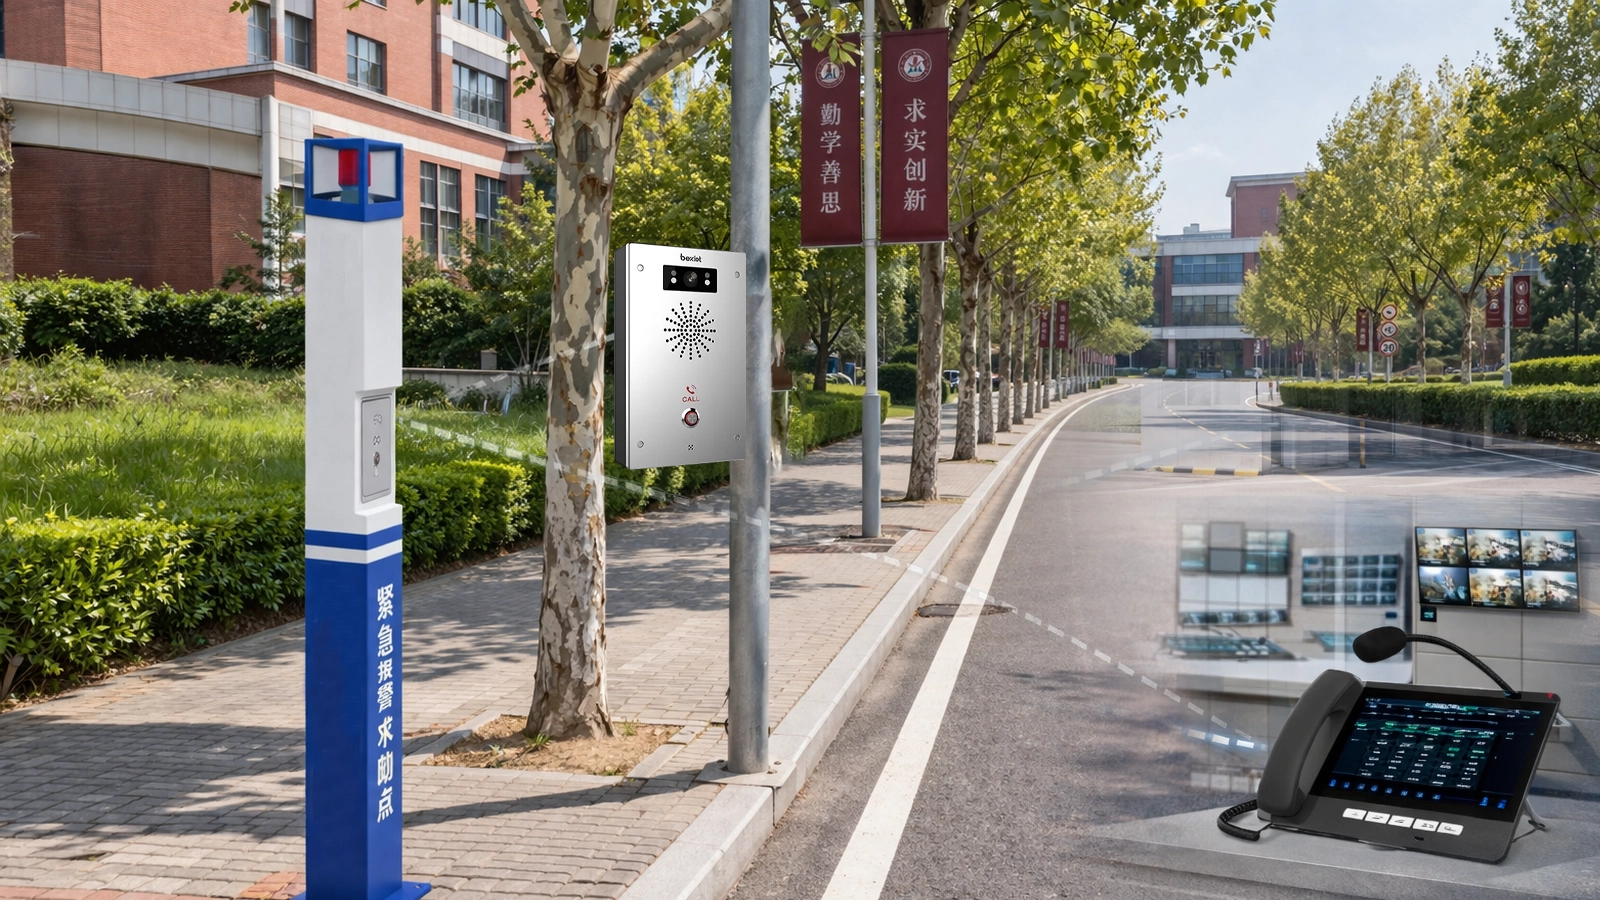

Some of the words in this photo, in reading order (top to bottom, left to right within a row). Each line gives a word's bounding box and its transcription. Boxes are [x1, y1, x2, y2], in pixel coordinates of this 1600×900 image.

[820, 102, 842, 214] 勤学善思
[903, 98, 927, 212] 求实创新
[1383, 344, 1394, 352] 30
[377, 583, 394, 823] 紧急报警求助点
